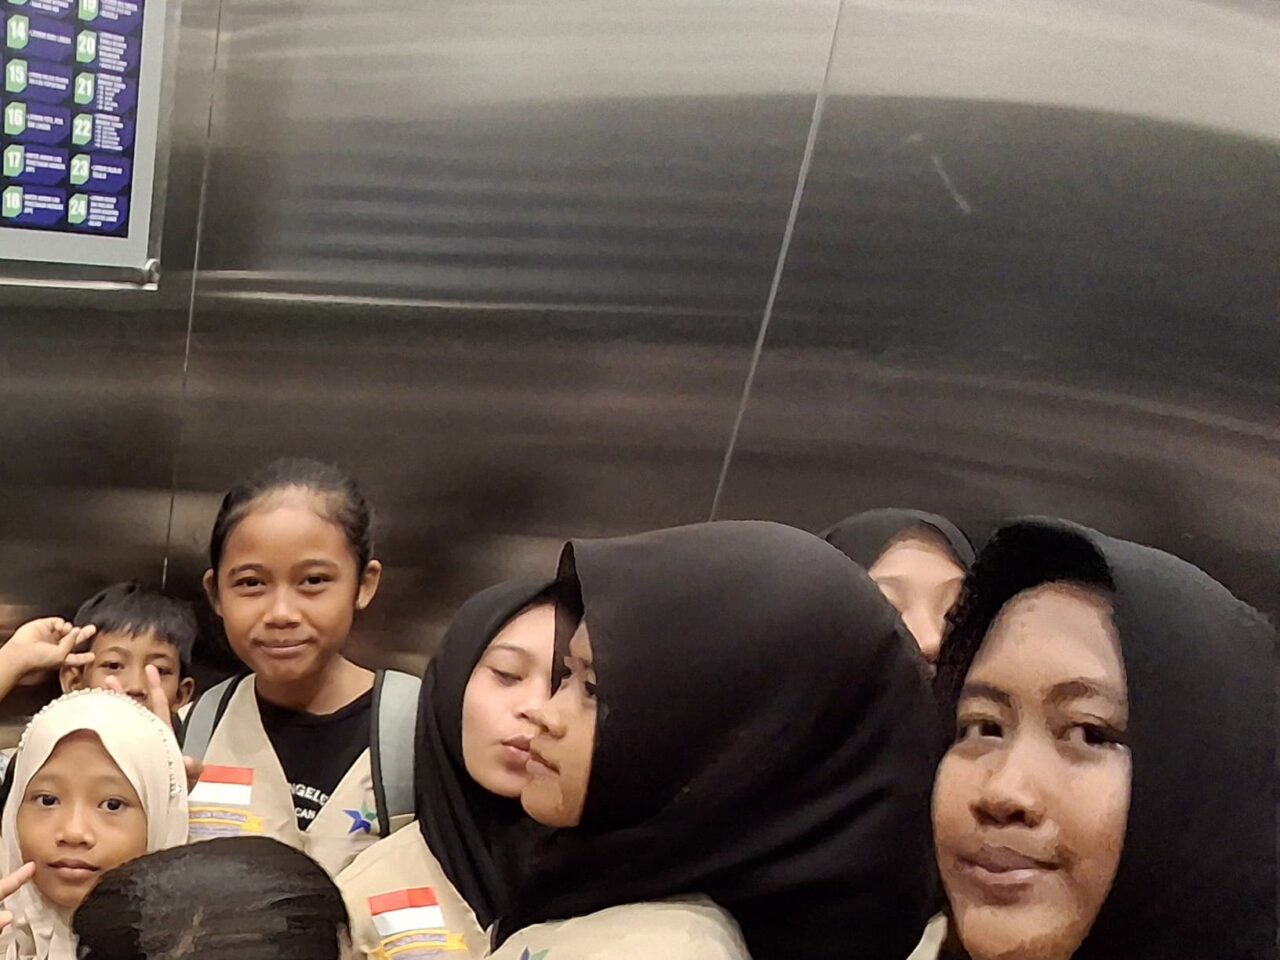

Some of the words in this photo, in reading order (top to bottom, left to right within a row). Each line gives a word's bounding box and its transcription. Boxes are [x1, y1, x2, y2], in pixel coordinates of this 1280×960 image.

[79, 35, 96, 55] 20
[77, 78, 92, 97] 21
[75, 117, 91, 137] 22
[7, 150, 21, 169] 17
[72, 160, 89, 177] 23
[70, 199, 87, 216] 24
